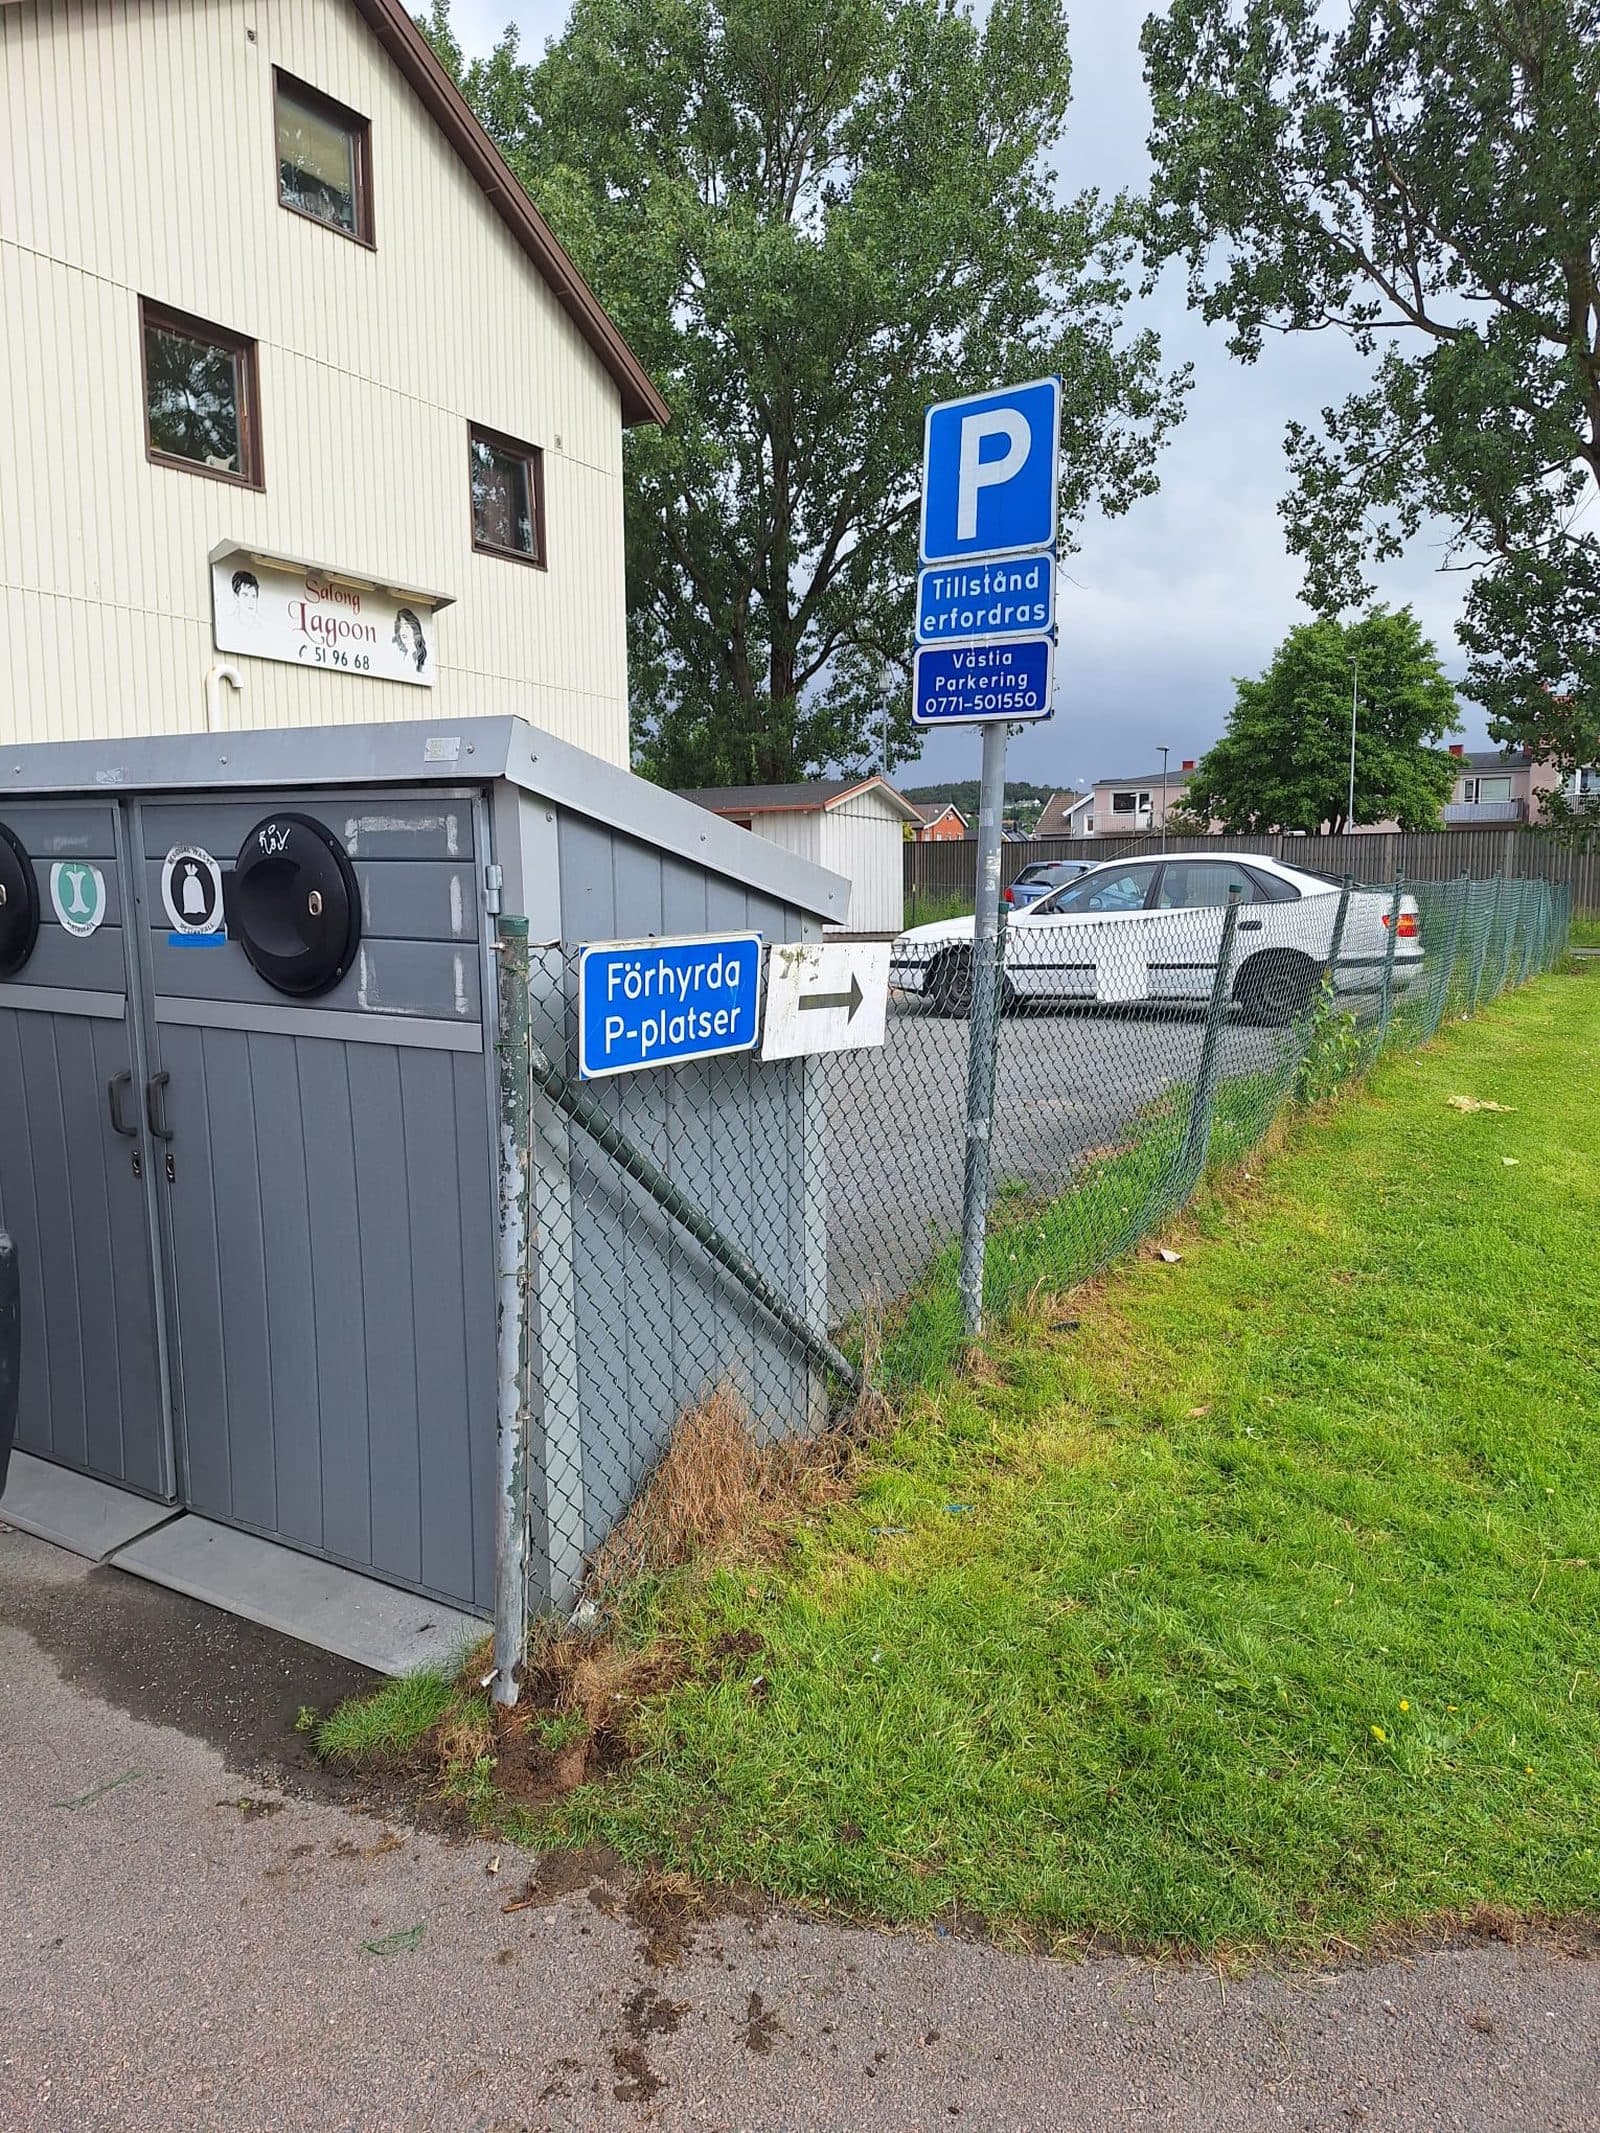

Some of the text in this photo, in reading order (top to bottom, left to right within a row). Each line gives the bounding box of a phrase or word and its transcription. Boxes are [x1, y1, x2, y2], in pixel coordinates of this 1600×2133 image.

[957, 408, 1031, 541] P
[304, 579, 361, 616] Salong
[933, 566, 1040, 601] Tillstånd
[288, 601, 377, 648] Lagoon
[923, 603, 1046, 632] erfordras
[315, 646, 370, 671] 51 96 68
[953, 650, 1013, 669] Västia
[935, 672, 1028, 692] Parkering
[925, 691, 1037, 714] 0771-501550
[607, 953, 741, 1002] Förhyrda
[604, 1007, 742, 1057] P-platser
